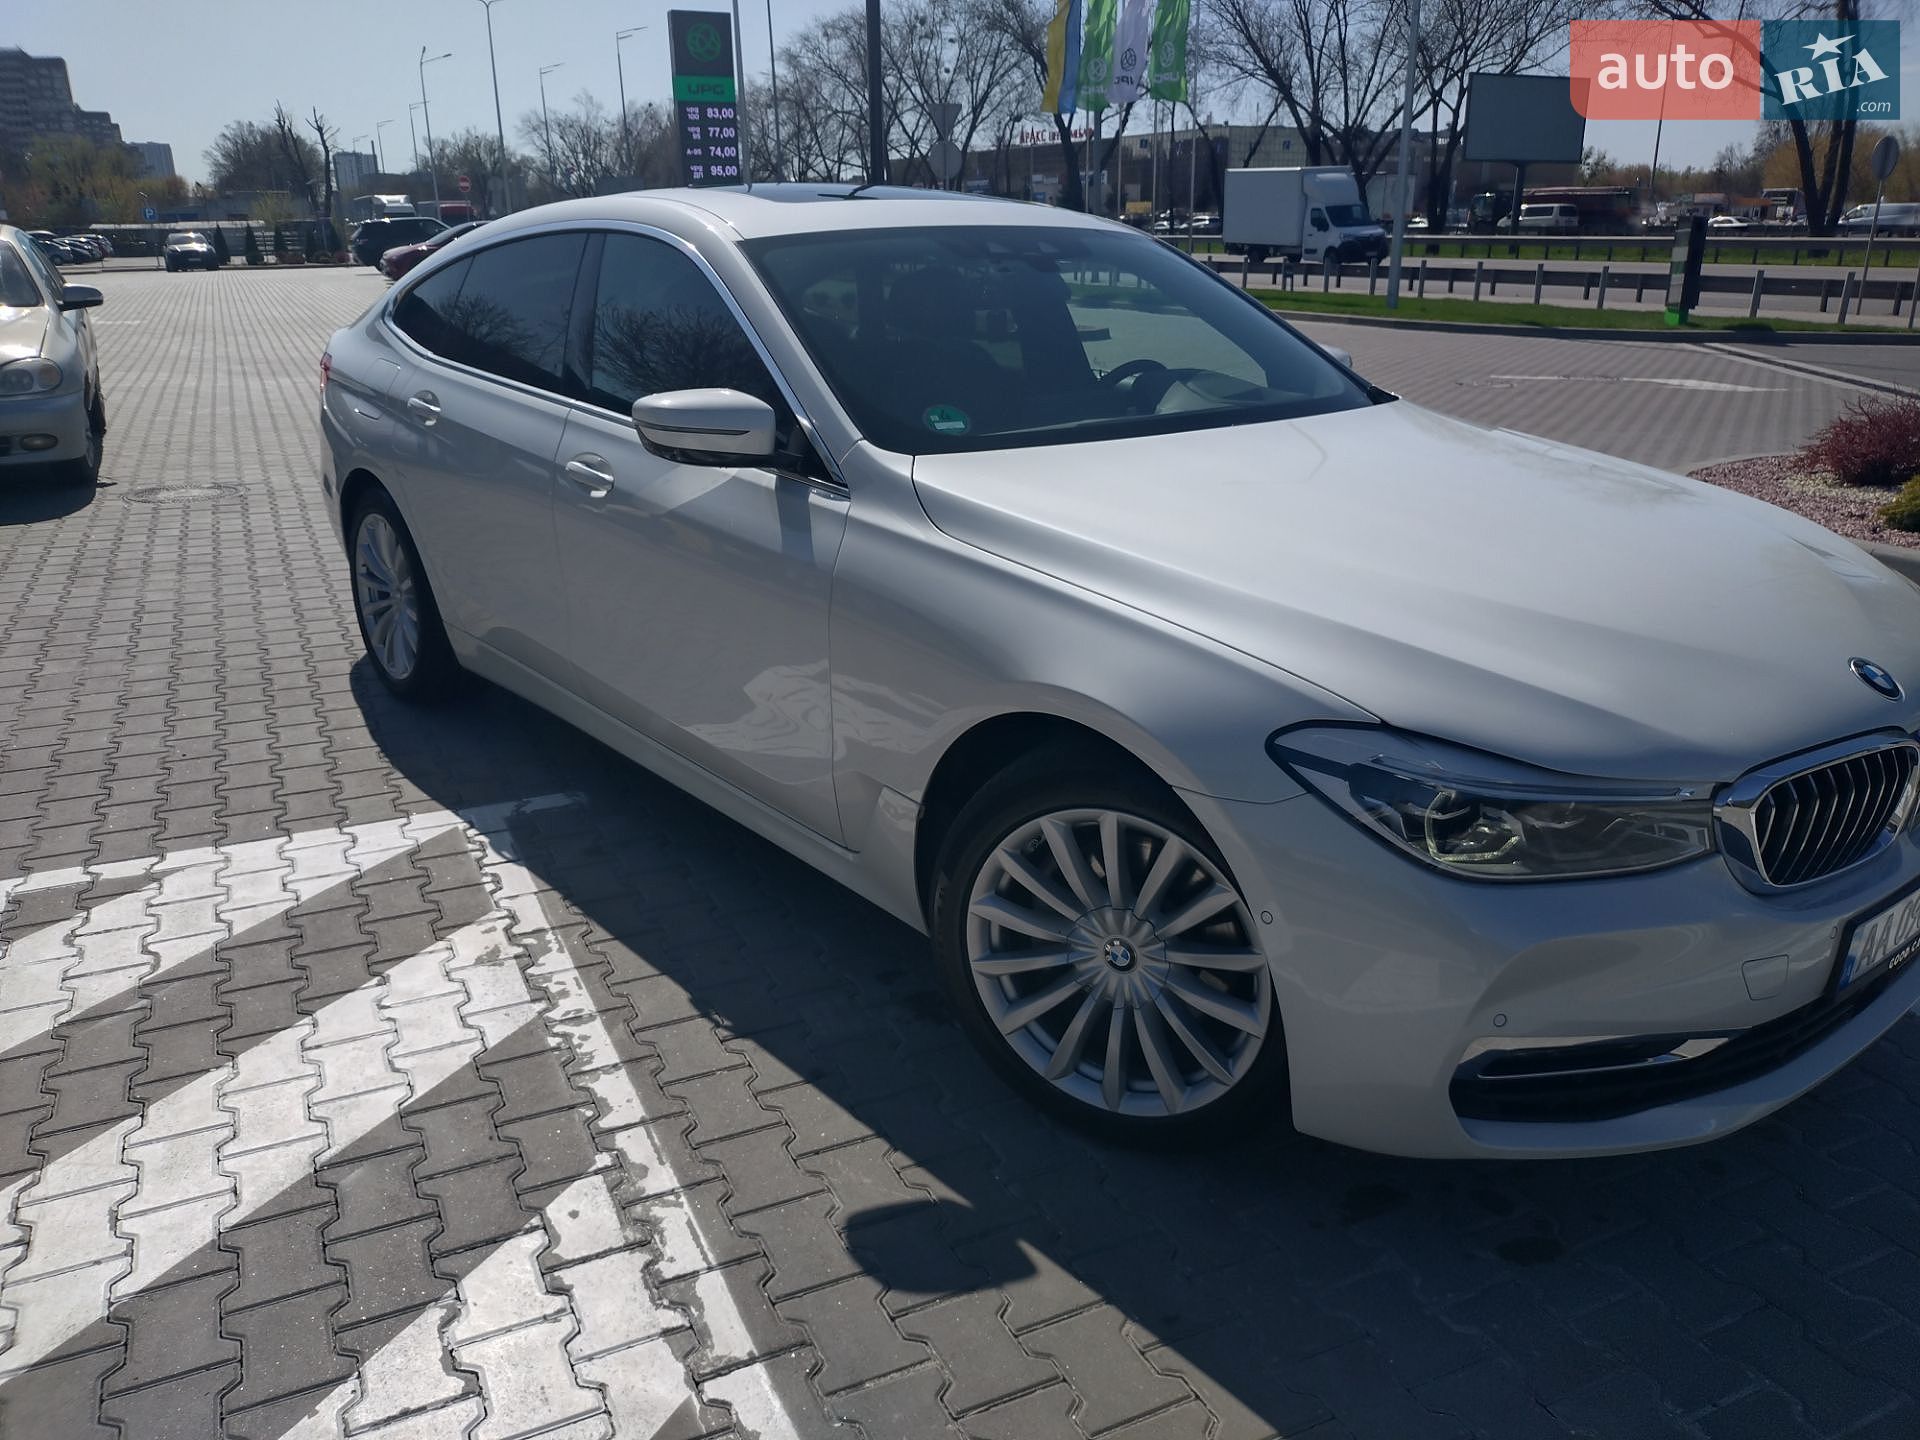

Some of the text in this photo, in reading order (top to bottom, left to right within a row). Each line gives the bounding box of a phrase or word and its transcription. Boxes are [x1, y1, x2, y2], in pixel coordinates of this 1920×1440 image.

[687, 83, 725, 96] UPG
[706, 107, 734, 120] 83,00
[708, 127, 736, 139] 77,00
[709, 146, 737, 159] 74,00
[710, 165, 738, 177] 95,00
